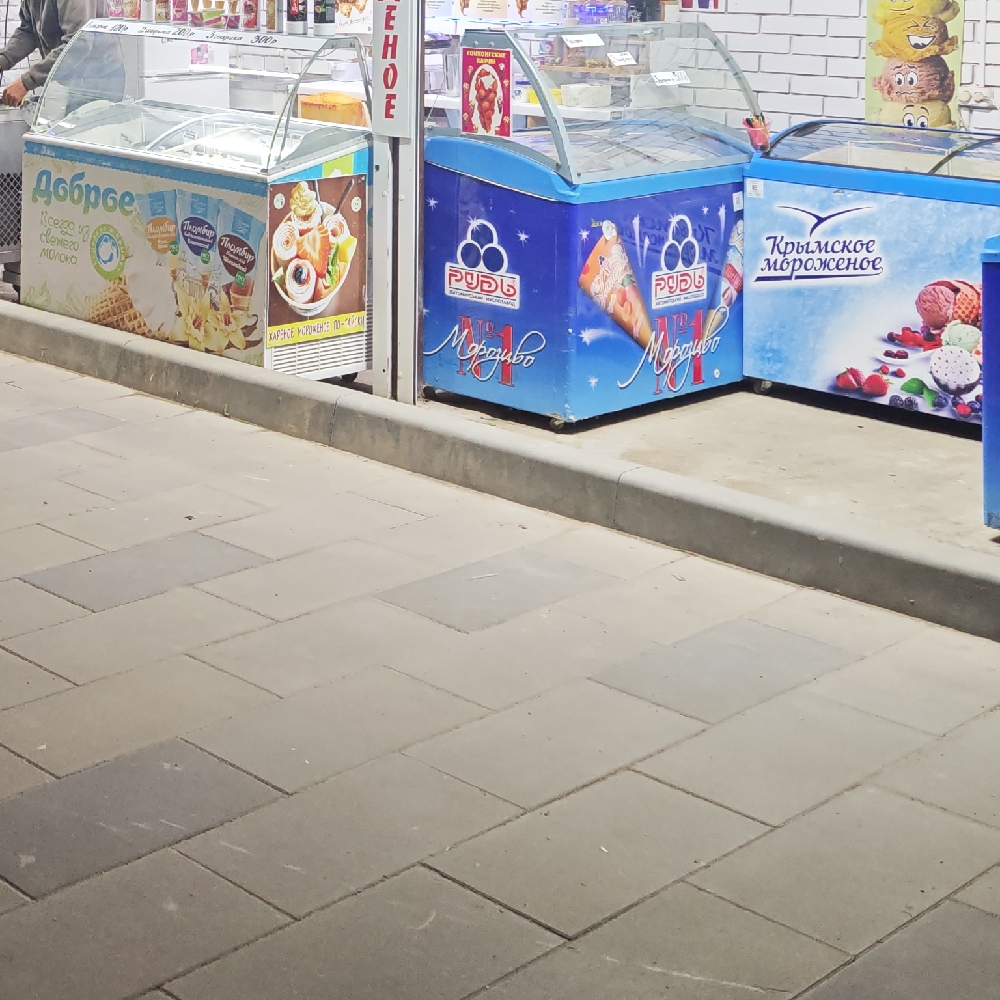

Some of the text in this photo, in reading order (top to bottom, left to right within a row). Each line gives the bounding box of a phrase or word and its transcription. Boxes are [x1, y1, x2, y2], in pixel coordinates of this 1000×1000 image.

[32, 169, 136, 216] Доброе
[40, 210, 75, 236] Всегда
[147, 220, 176, 234] Пломбир
[183, 220, 215, 238] Пломбир
[40, 234, 79, 251] свежего
[220, 236, 255, 262] Пломбир
[766, 235, 876, 258] Крымское
[40, 247, 78, 266] молока
[760, 256, 883, 281] мороженое
[449, 268, 517, 298] РУДЬ
[655, 270, 705, 299] РУДЬ
[269, 327, 294, 342] ЖАРЕНОЕ
[297, 321, 330, 338] МОРОЖЕНОЕ
[423, 324, 547, 382] Морозиво
[617, 305, 729, 392] Морозиво
